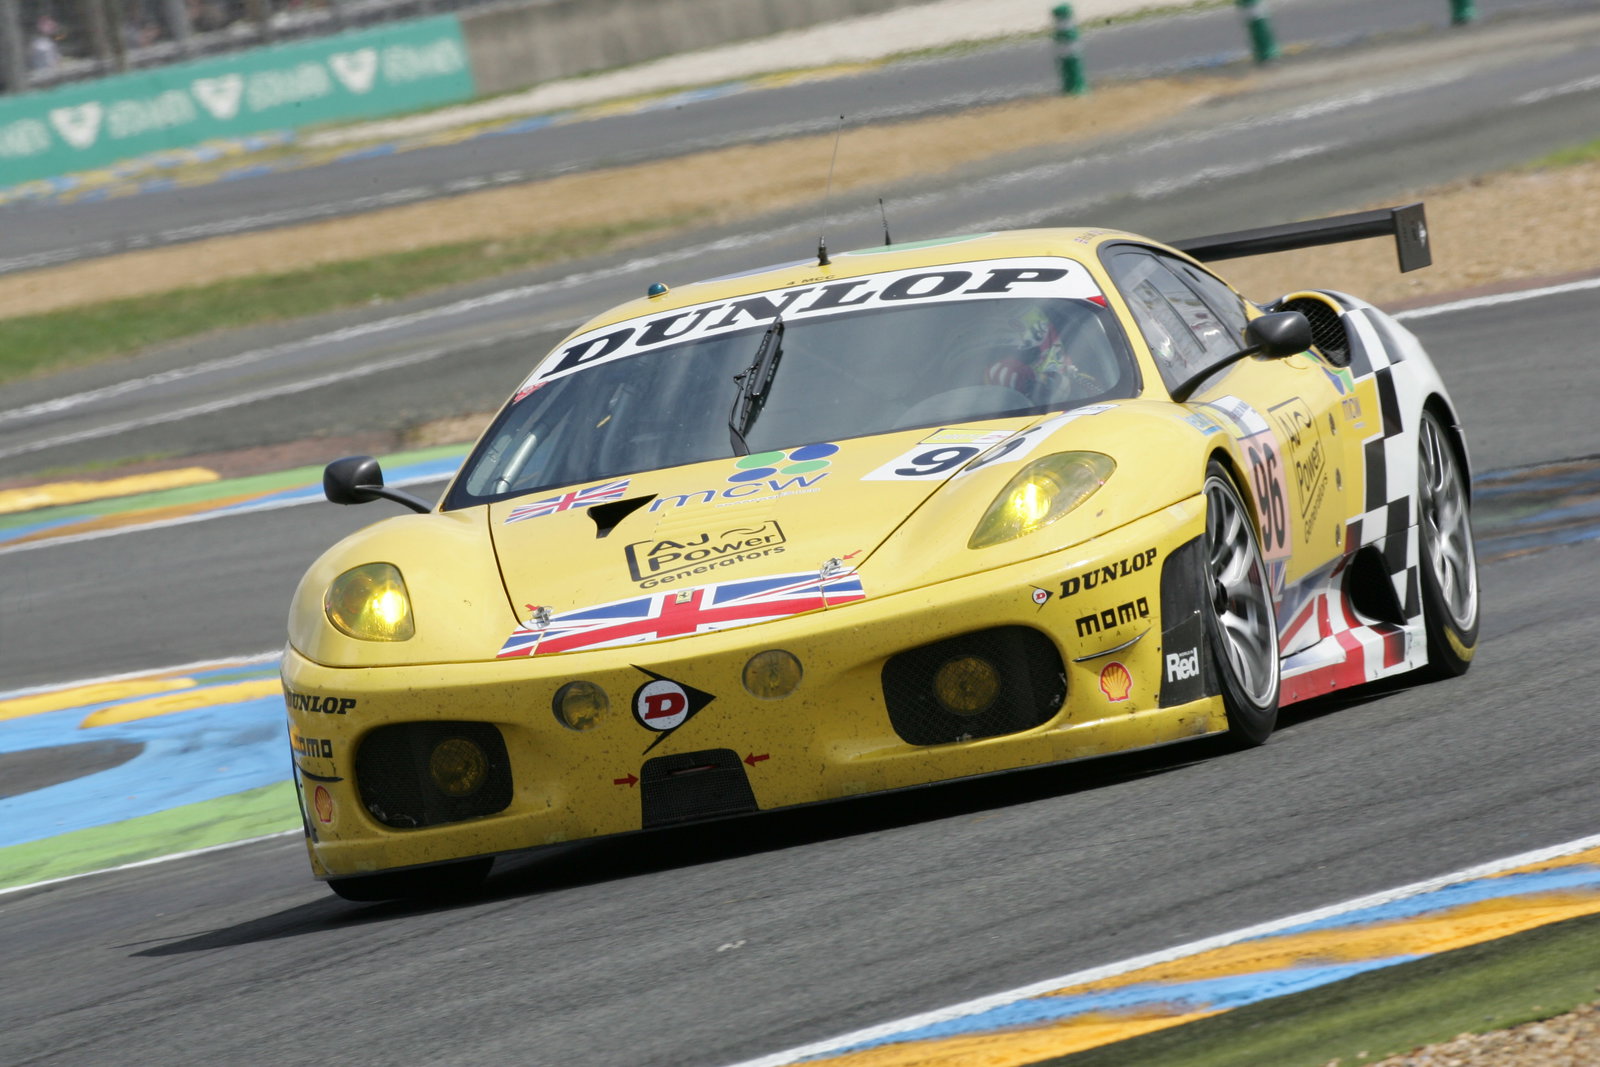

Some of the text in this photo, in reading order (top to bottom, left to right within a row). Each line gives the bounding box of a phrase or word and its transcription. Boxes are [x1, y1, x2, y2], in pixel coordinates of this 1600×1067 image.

[540, 267, 1069, 379] DUNLOP
[647, 472, 829, 514] mcw
[1248, 442, 1286, 552] 96
[646, 533, 710, 557] AJ
[647, 534, 776, 572] Power
[639, 545, 786, 590] Generators
[1059, 547, 1157, 600] DUNLOP
[1075, 596, 1150, 638] momo
[1166, 646, 1200, 683] Red
